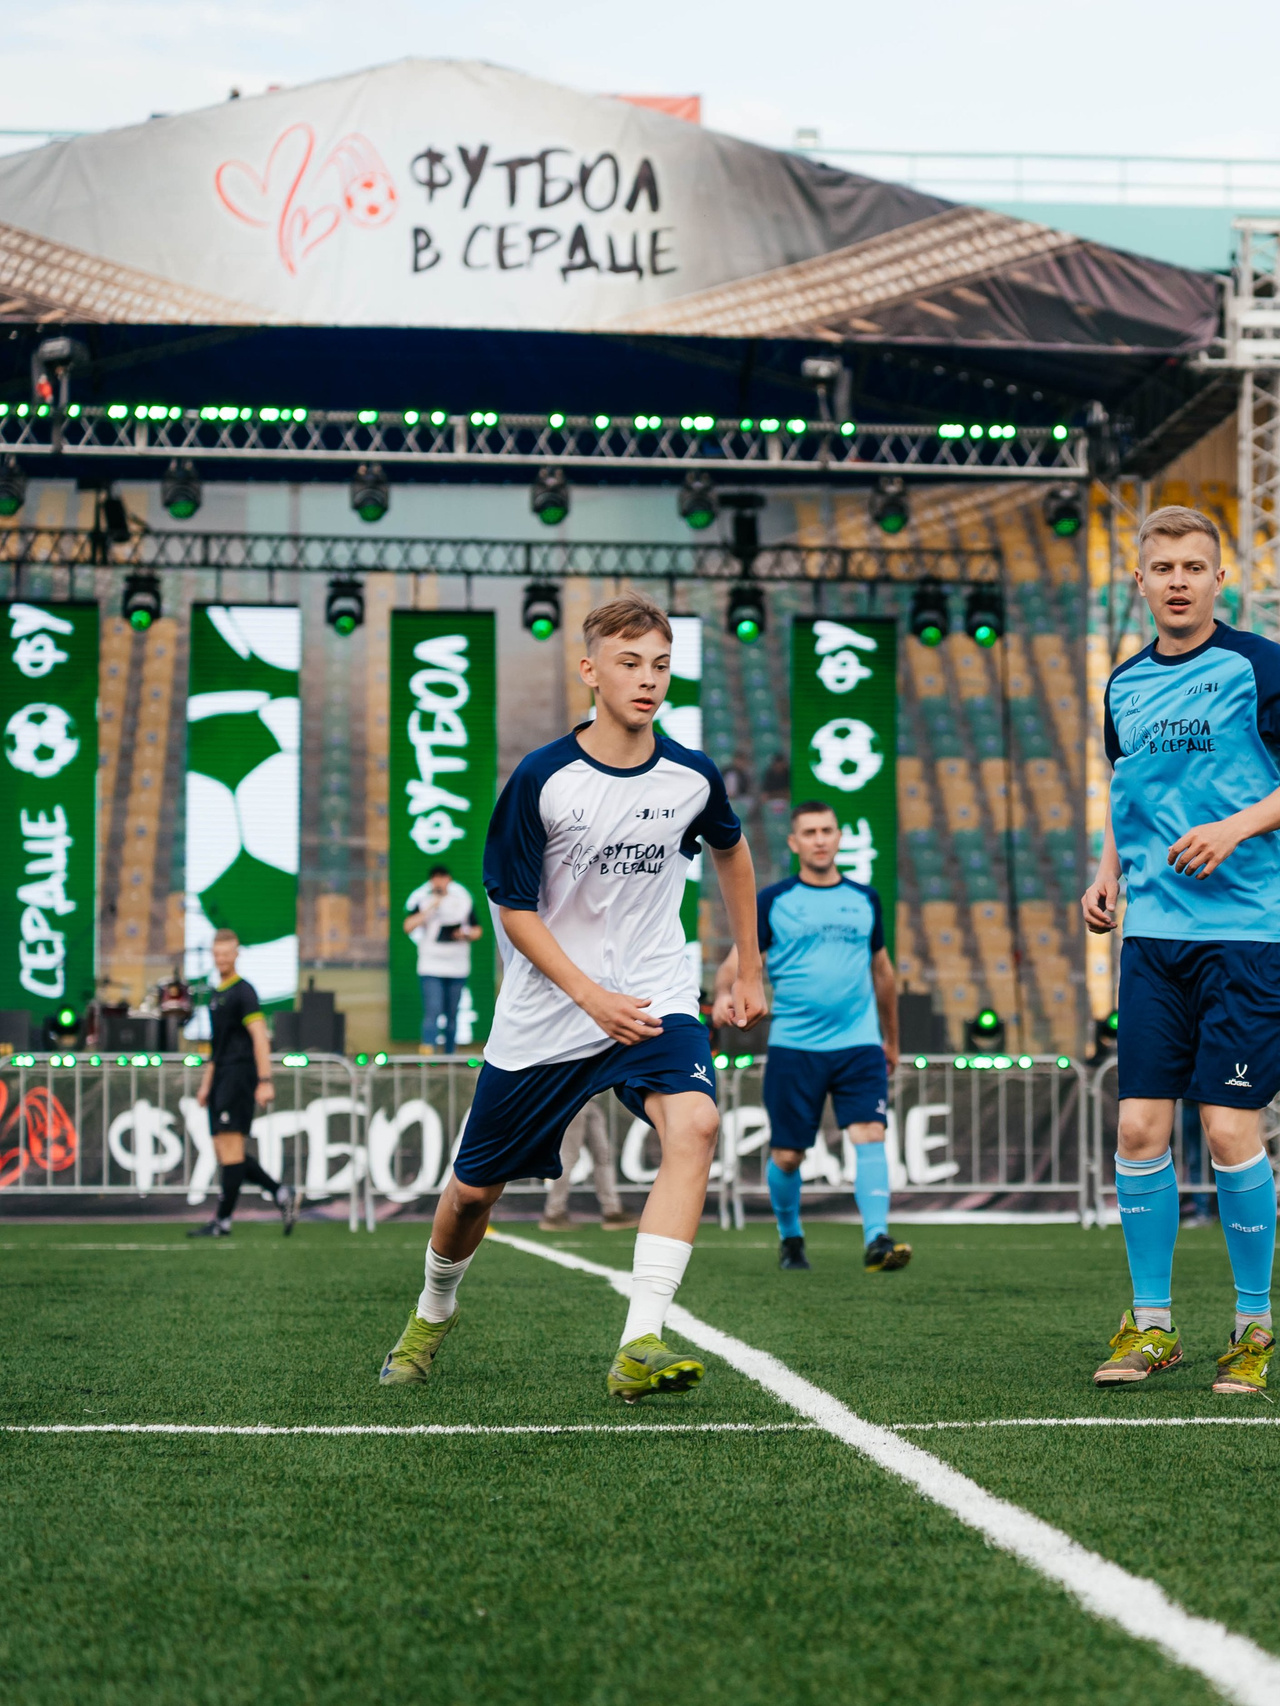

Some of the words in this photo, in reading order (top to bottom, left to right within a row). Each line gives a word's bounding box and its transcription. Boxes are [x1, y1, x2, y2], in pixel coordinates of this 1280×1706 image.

[410, 144, 660, 213] ФУТБОЛ
[412, 226, 441, 273] В
[462, 222, 678, 283] СЕРДЦЕ
[1152, 719, 1211, 738] ФУТБОЛ
[405, 634, 471, 855] ФУТБОЛ
[1149, 741, 1158, 755] В
[1161, 738, 1216, 755] СЕРДЦЕ
[602, 842, 665, 860] ФУТБОЛ
[600, 862, 609, 875] В
[16, 803, 77, 999] СЕРДЦЕ
[1228, 1223, 1268, 1233] JÖGEL
